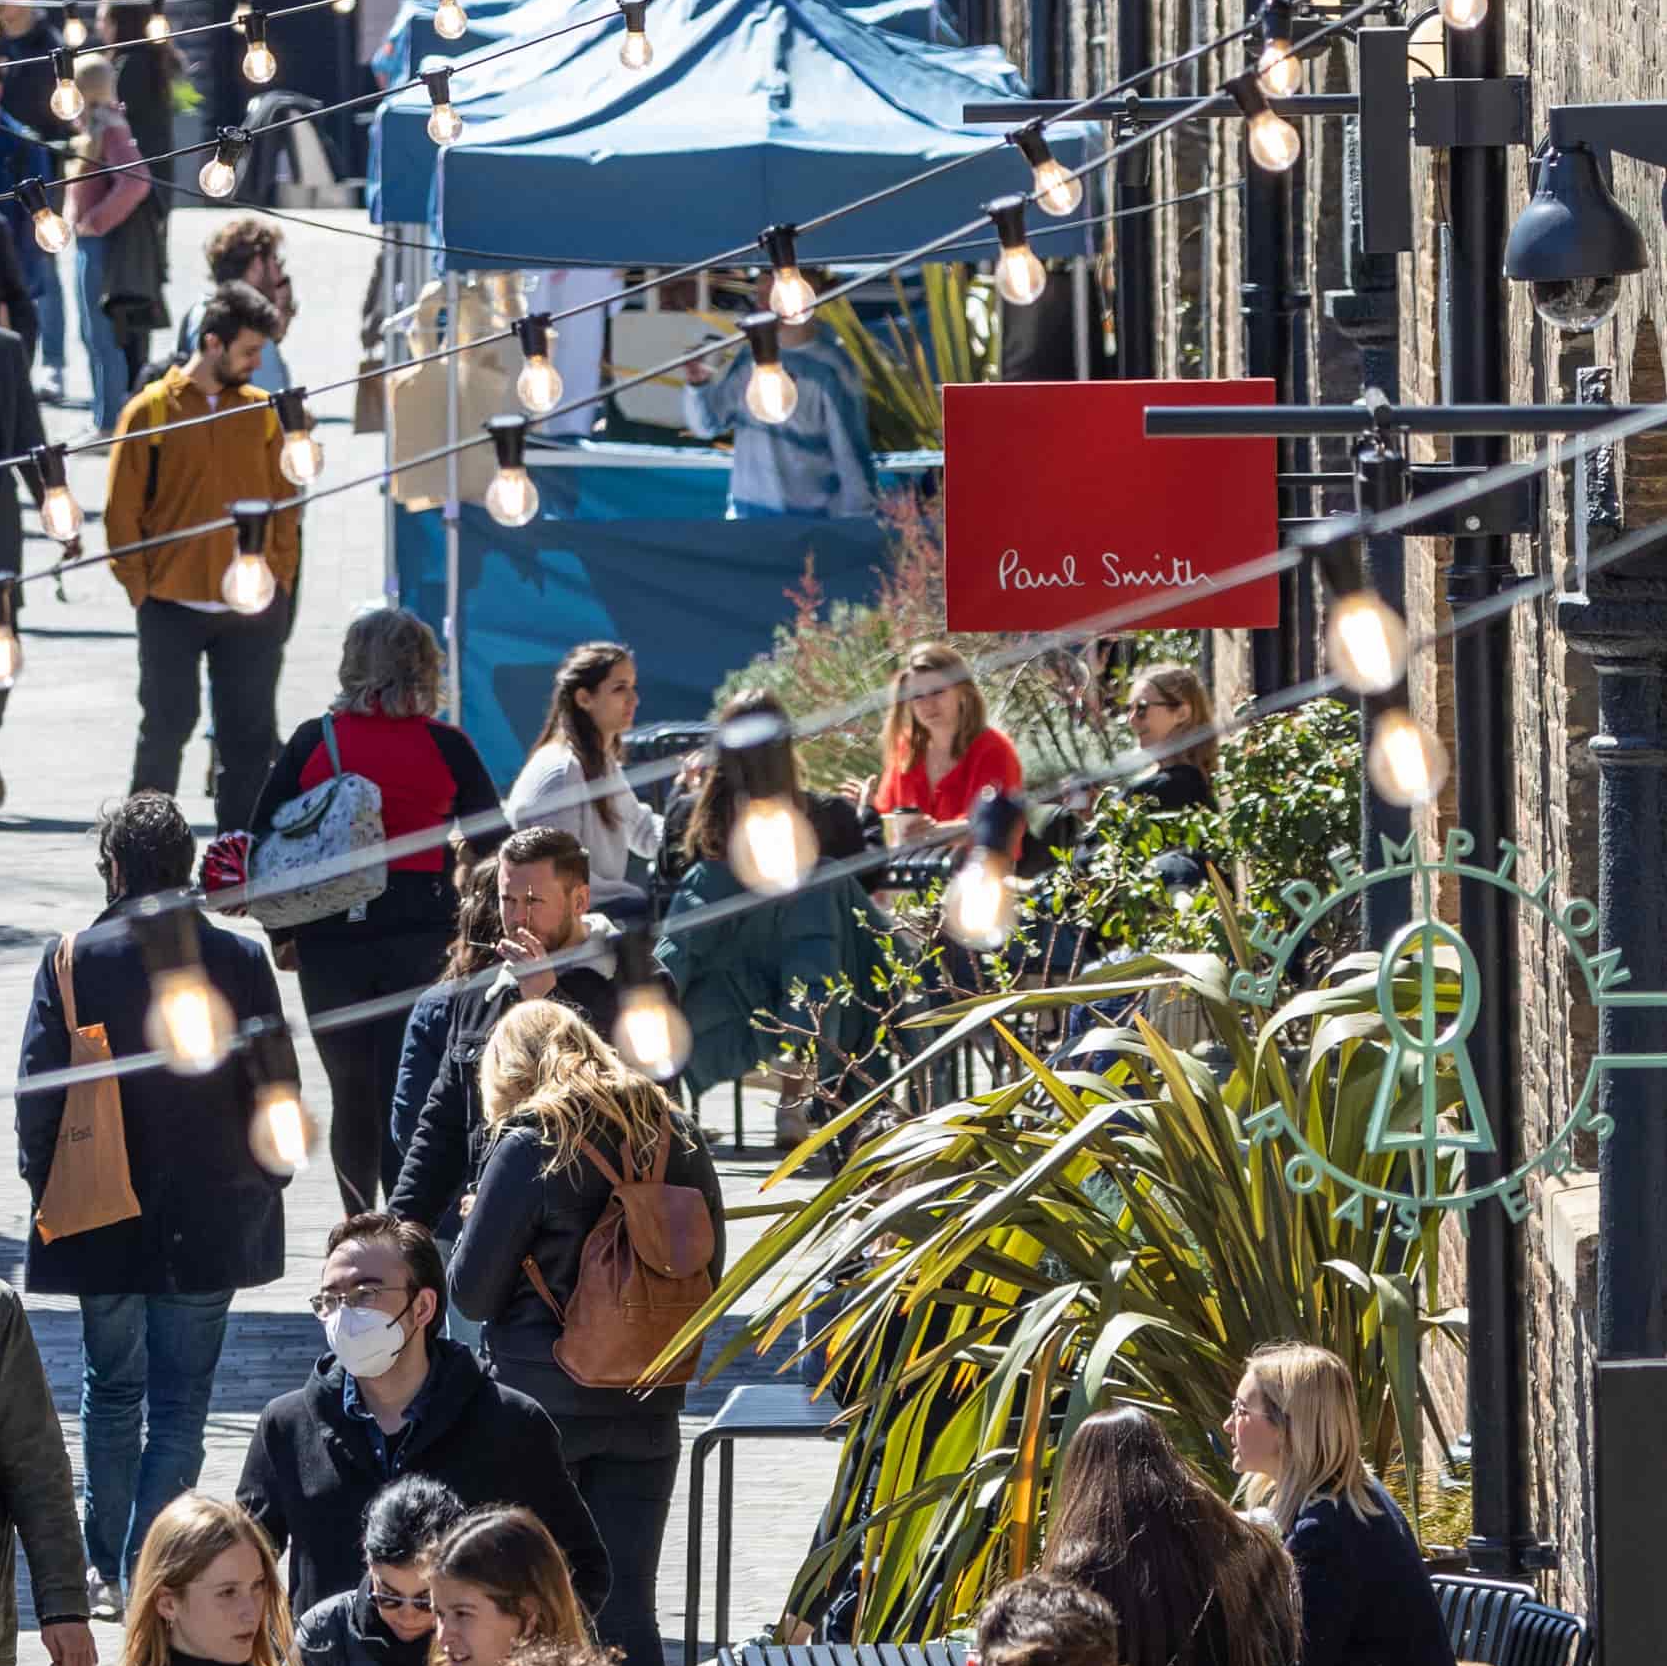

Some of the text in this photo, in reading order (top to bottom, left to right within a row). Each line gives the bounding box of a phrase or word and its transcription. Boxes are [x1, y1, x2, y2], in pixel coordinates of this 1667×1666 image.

[998, 549, 1216, 592] Paul Smith
[1229, 828, 1632, 1007] REDEMPTION
[1243, 1101, 1616, 1241] ROASTERS
